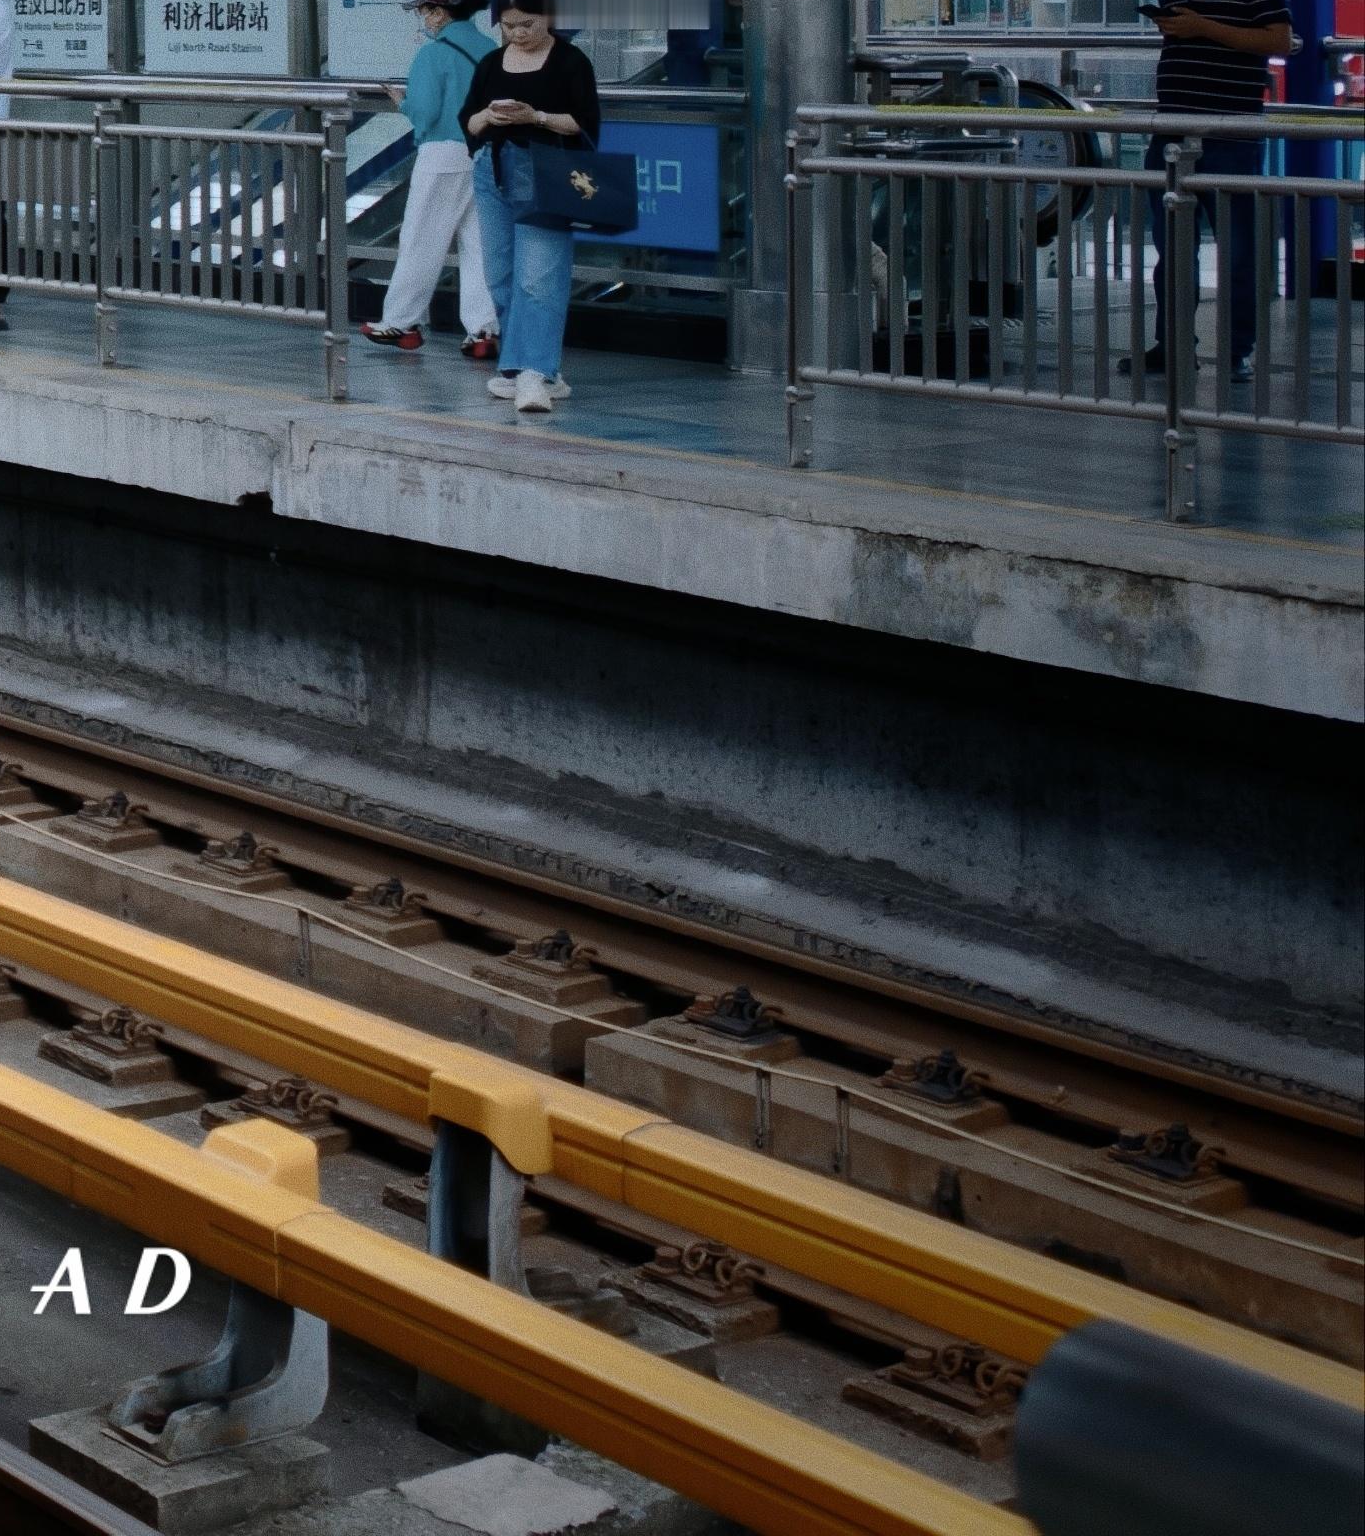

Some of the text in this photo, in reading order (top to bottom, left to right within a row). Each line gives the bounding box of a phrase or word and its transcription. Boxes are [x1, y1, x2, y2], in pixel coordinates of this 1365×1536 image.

[163, 1, 269, 31] 利济北路站
[183, 42, 206, 53] North
[208, 42, 230, 53] Road
[232, 42, 264, 53] Station
[638, 197, 658, 215] xit
